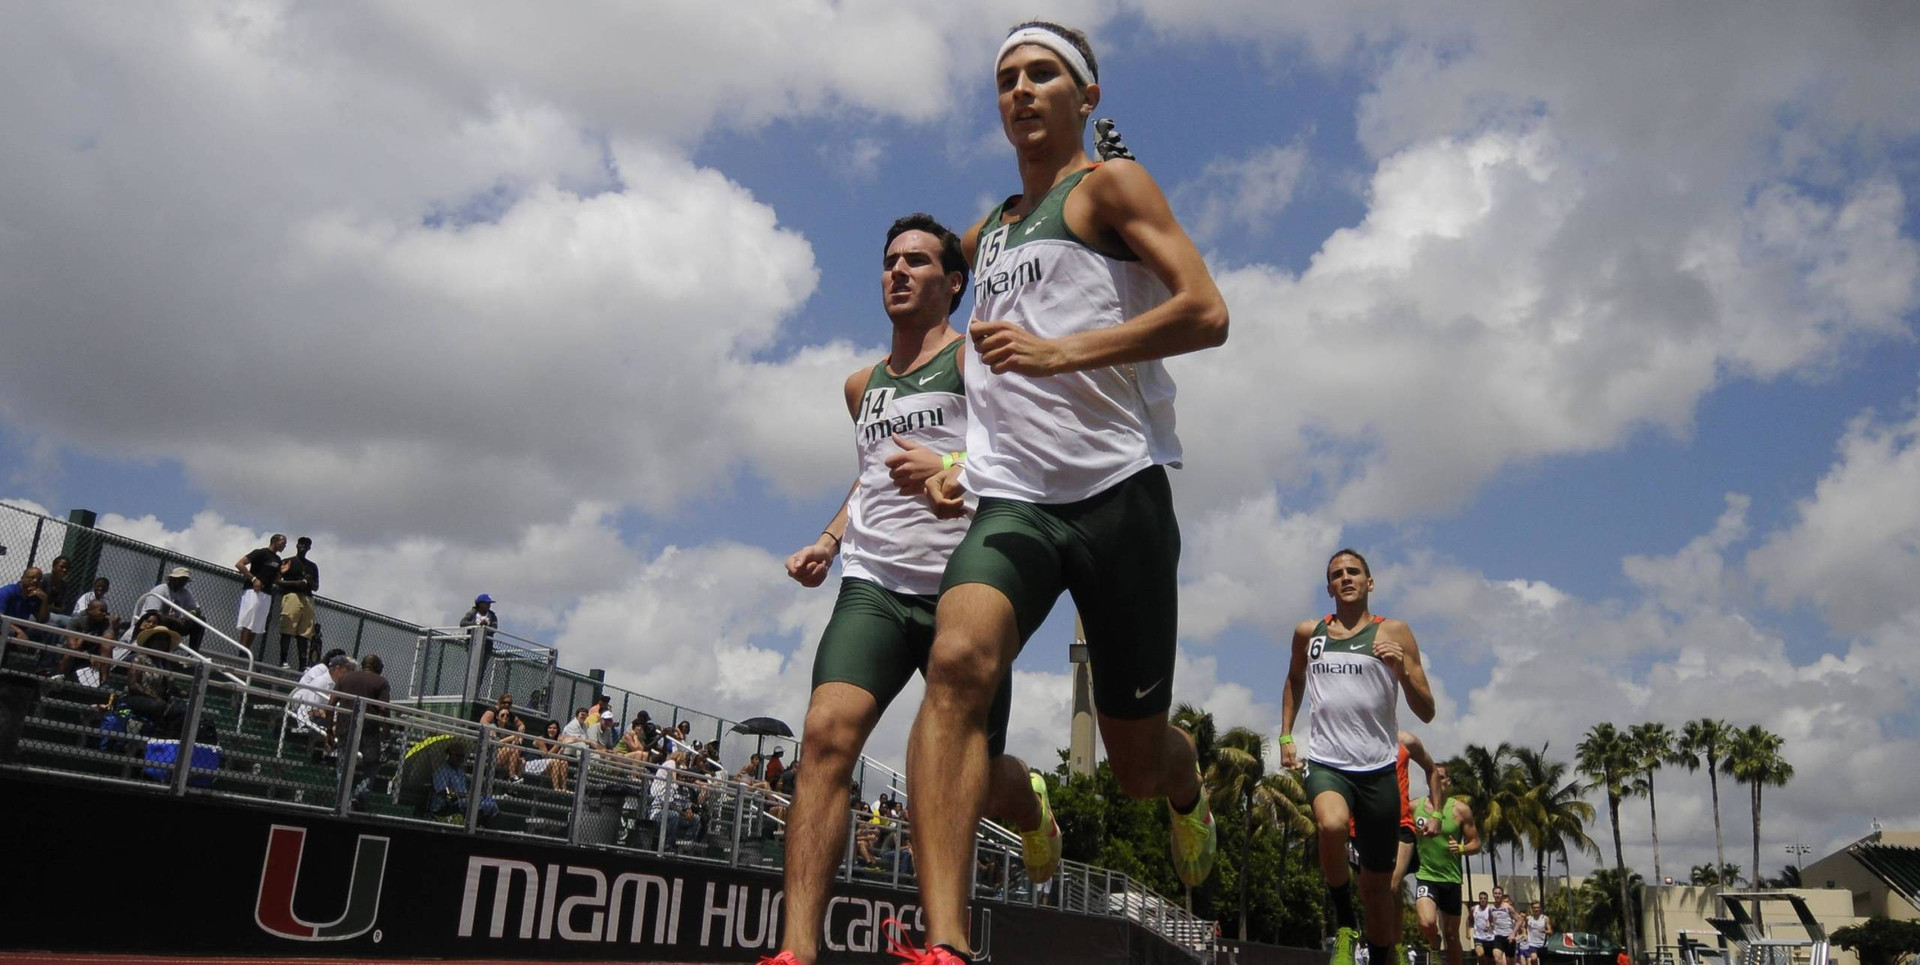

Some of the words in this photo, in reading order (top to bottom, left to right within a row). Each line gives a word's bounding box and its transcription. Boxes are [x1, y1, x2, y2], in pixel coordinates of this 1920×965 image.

[980, 230, 1004, 272] 15
[865, 389, 888, 422] 14
[1310, 638, 1323, 660] 6
[254, 824, 390, 942] U
